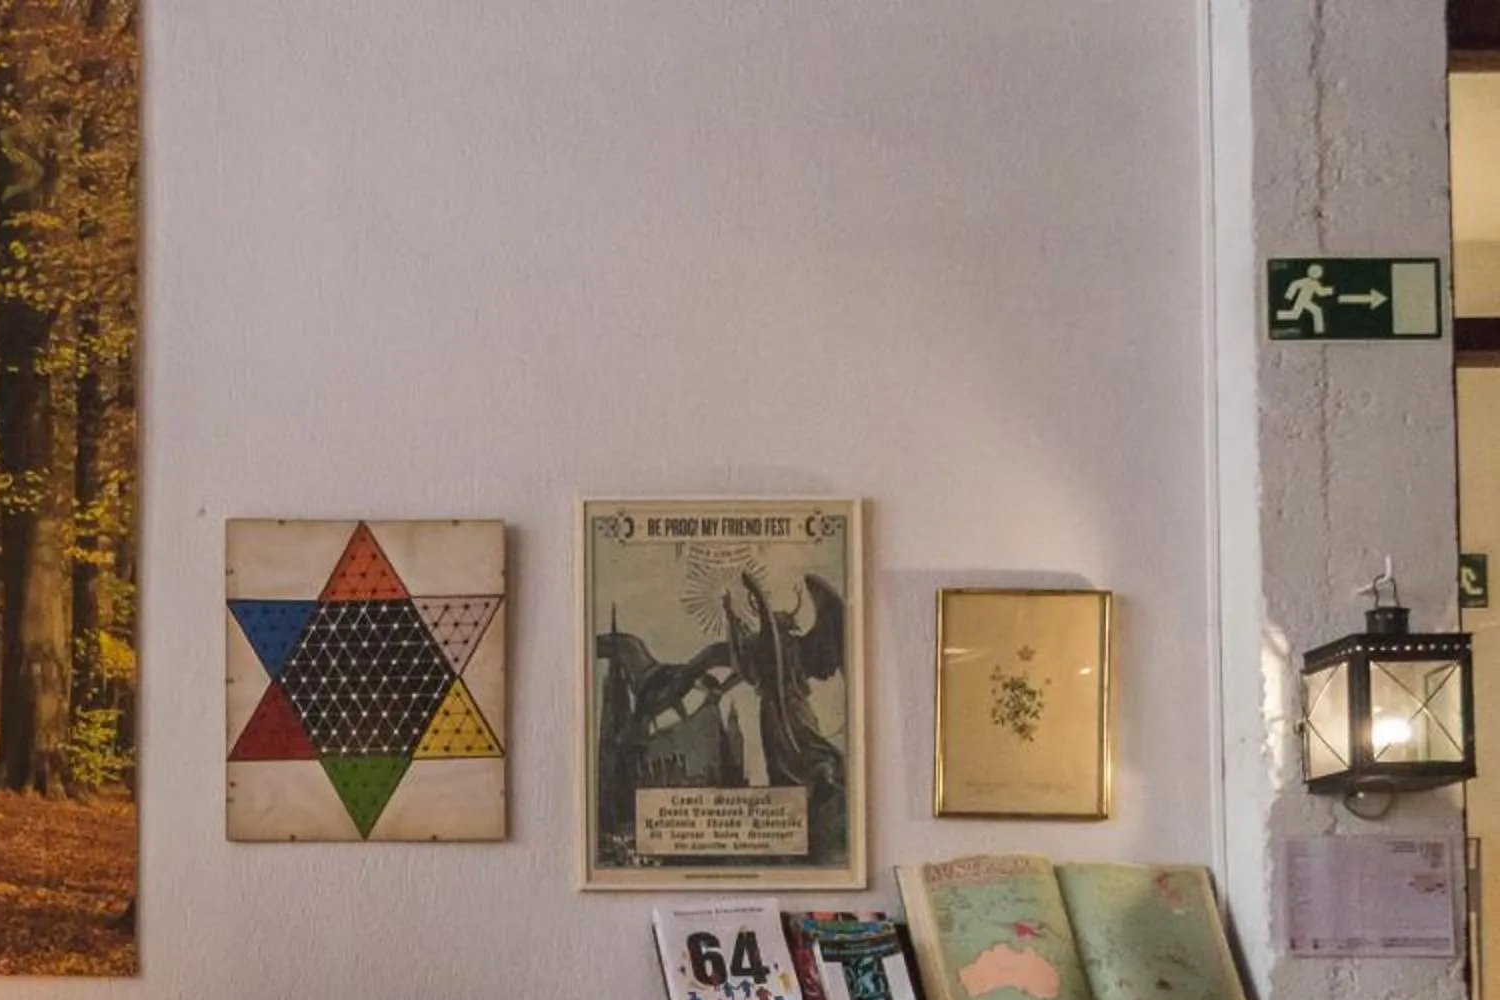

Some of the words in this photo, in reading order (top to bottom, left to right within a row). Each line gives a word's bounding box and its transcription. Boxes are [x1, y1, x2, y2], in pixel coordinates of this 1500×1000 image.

[647, 517, 662, 537] BE
[701, 517, 719, 536] MY
[722, 517, 762, 536] FRIEND
[765, 517, 792, 536] FEST
[686, 927, 770, 987] 64
